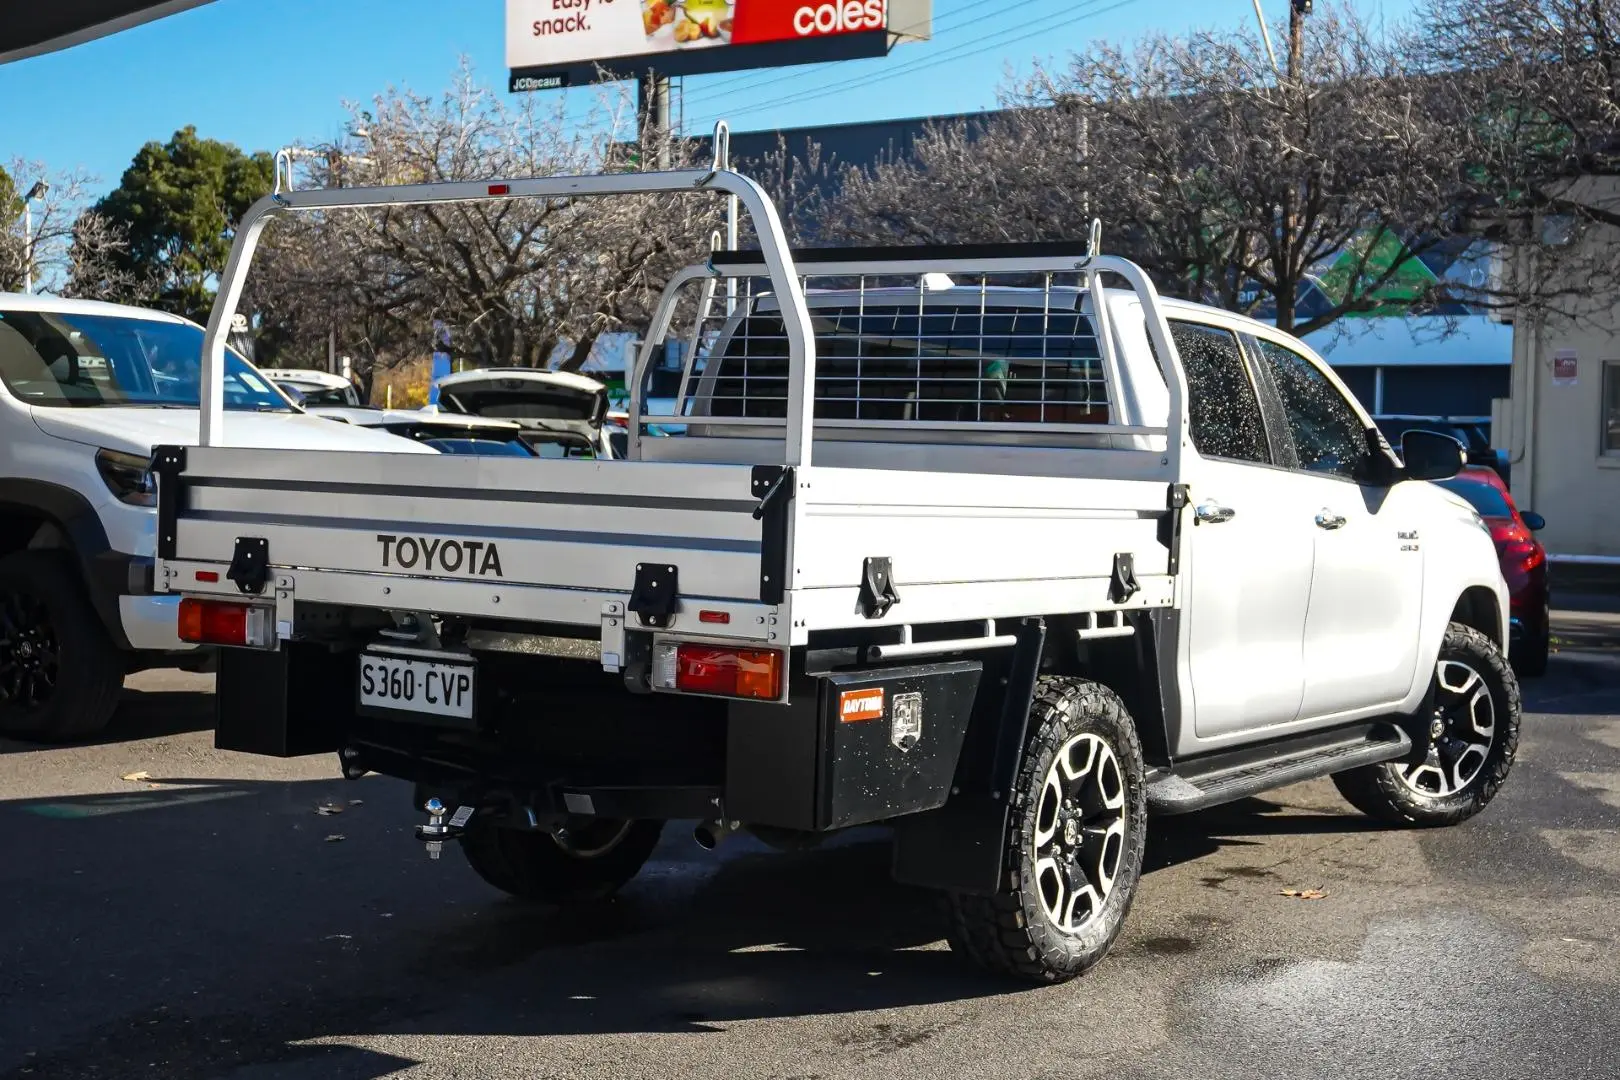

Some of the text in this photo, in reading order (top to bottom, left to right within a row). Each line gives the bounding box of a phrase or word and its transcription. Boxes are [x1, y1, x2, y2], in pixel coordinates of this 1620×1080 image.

[533, 11, 591, 36] snack.
[793, 0, 881, 35] coles
[513, 76, 561, 91] JCDecaux
[377, 534, 503, 577] TOYOTA
